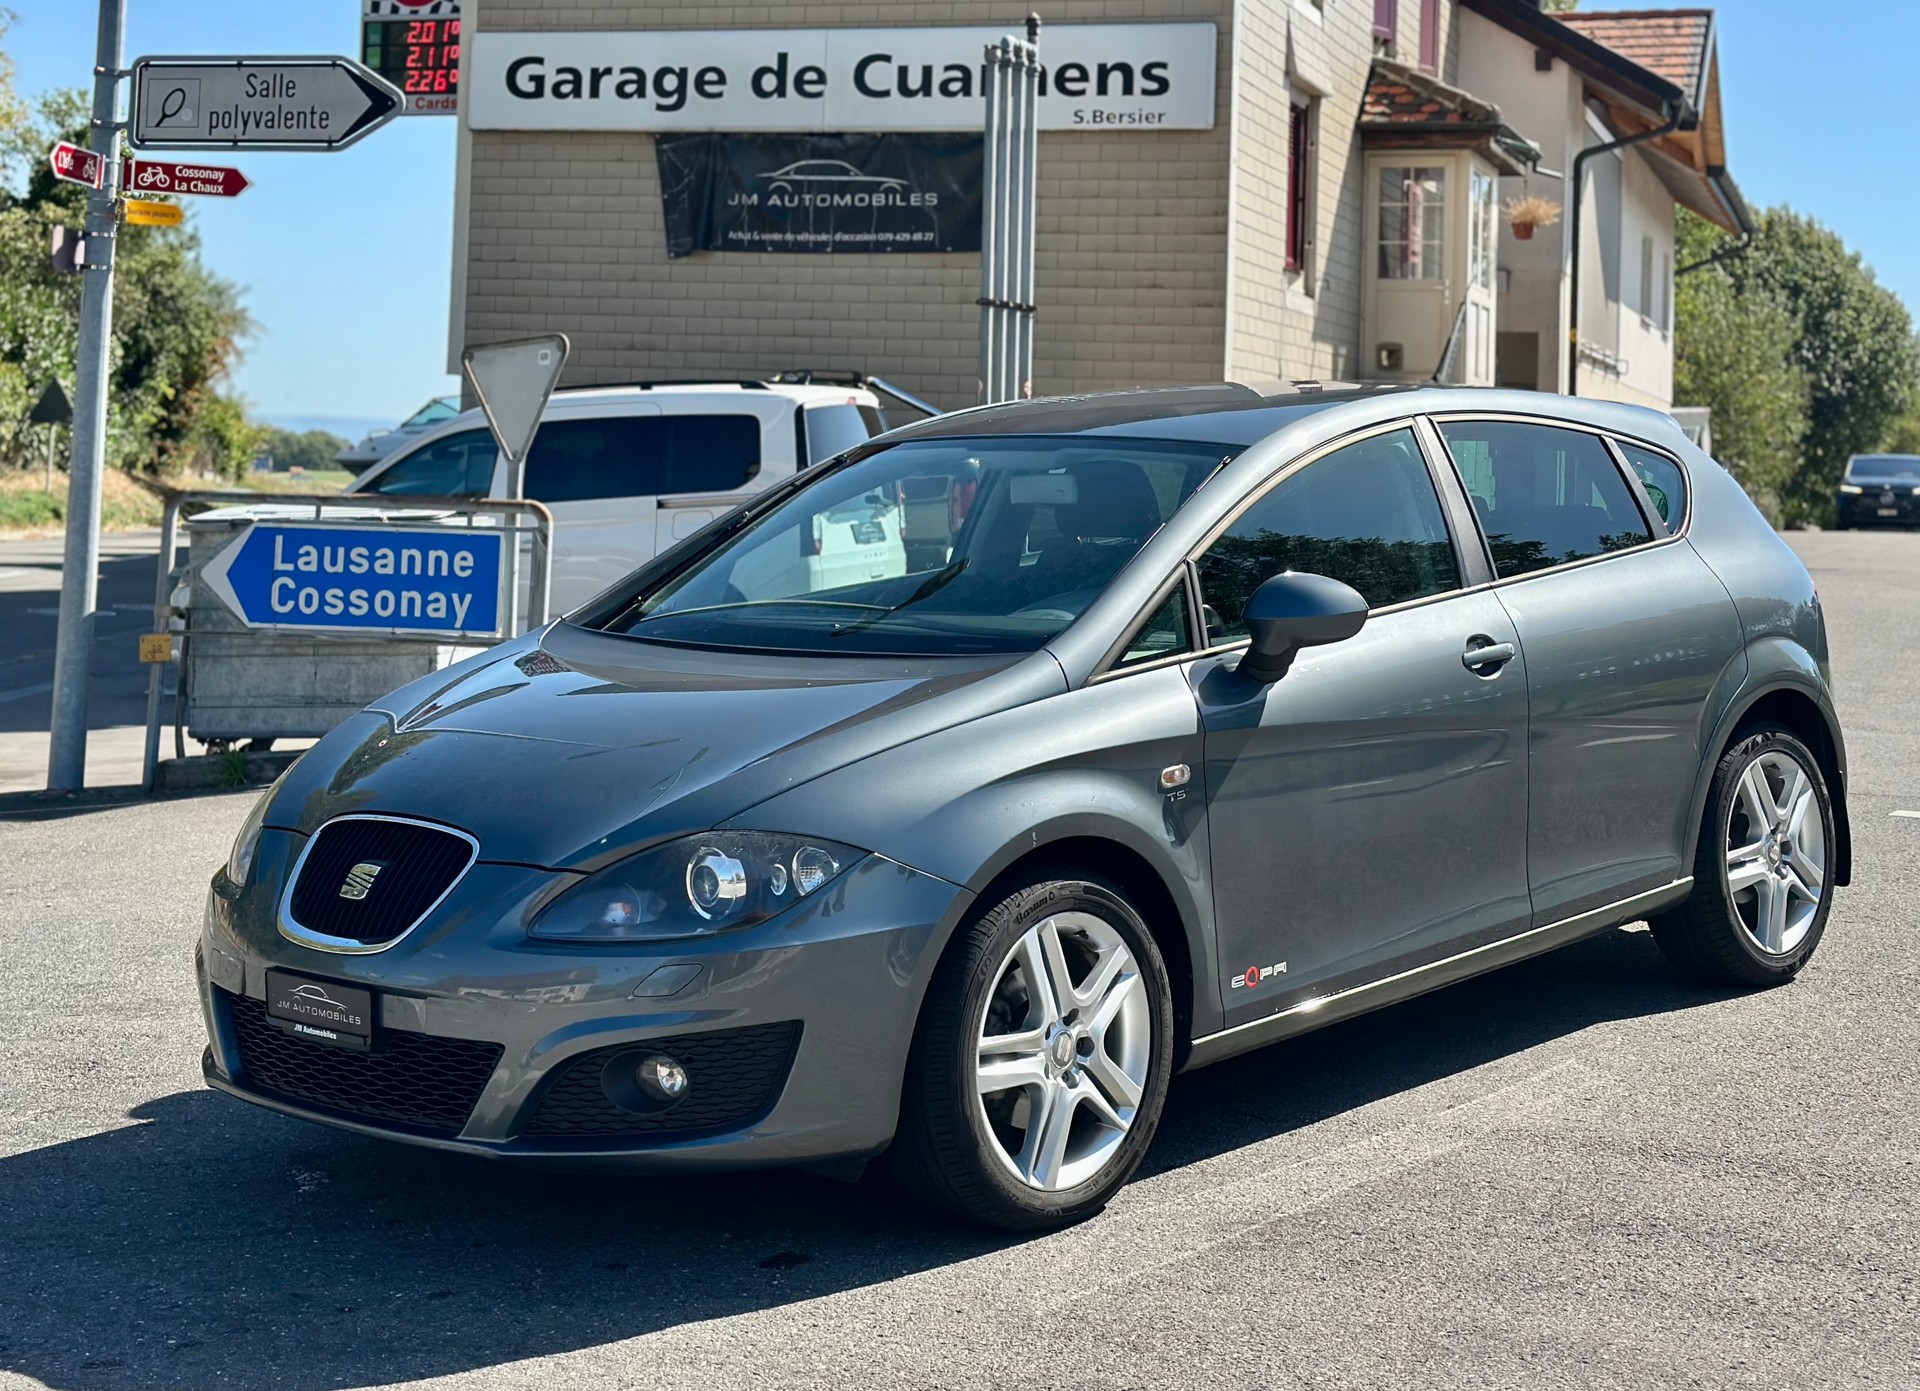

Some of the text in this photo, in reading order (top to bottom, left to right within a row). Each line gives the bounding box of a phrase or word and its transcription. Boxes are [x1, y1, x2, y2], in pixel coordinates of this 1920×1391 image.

[245, 73, 296, 98] Salle
[505, 52, 1170, 112] Garage de Cuaens
[208, 104, 329, 135] polyvalente
[1073, 109, 1166, 124] S.Bersier
[174, 179, 224, 194] La Chaux
[175, 165, 225, 183] Cossonay
[727, 192, 939, 207] JM AUTOMOBILES
[728, 230, 751, 240] Achat
[761, 232, 784, 241] vente
[784, 231, 794, 241] de
[878, 232, 894, 241] 079
[274, 534, 474, 578] Lausanne
[271, 576, 473, 628] Cossonay
[1231, 961, 1287, 989] COPA
[277, 1000, 361, 1025] JM AUTOMOBILES
[303, 1025, 337, 1040] Automobiles
